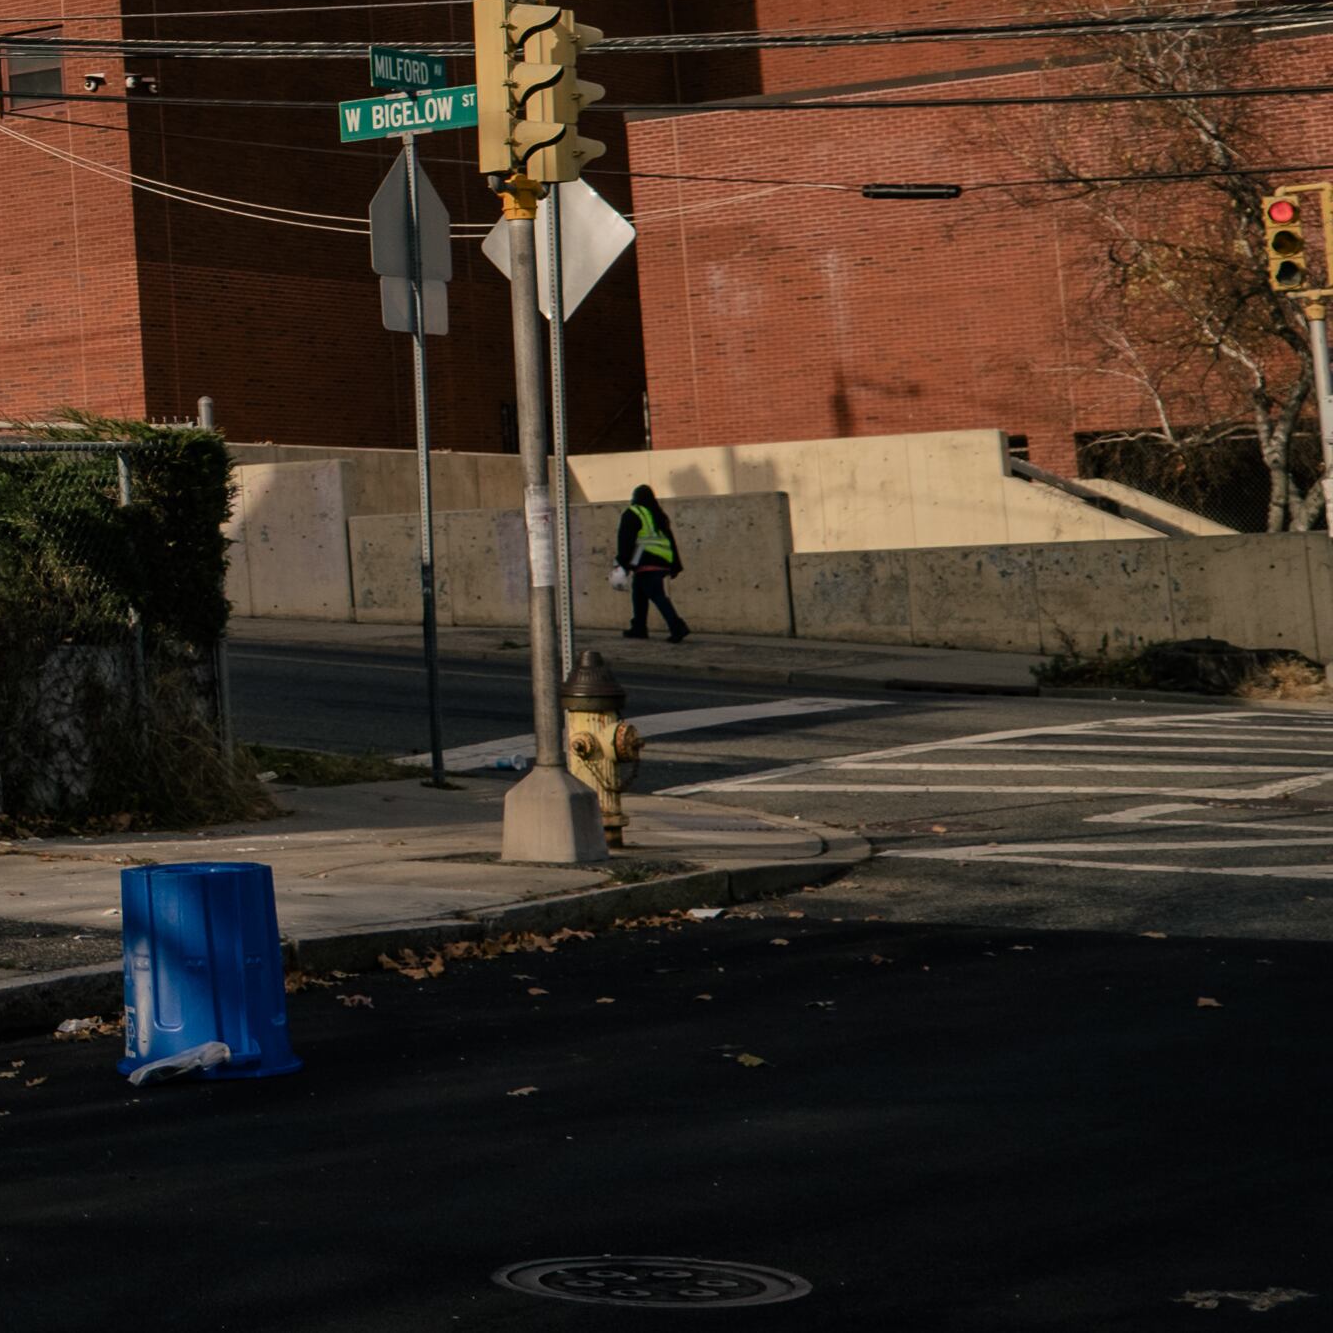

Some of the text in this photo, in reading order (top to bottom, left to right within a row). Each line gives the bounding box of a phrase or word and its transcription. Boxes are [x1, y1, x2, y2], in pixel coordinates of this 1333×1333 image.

[374, 54, 429, 85] MILFORD
[345, 93, 475, 132] W BIGELOW ST
